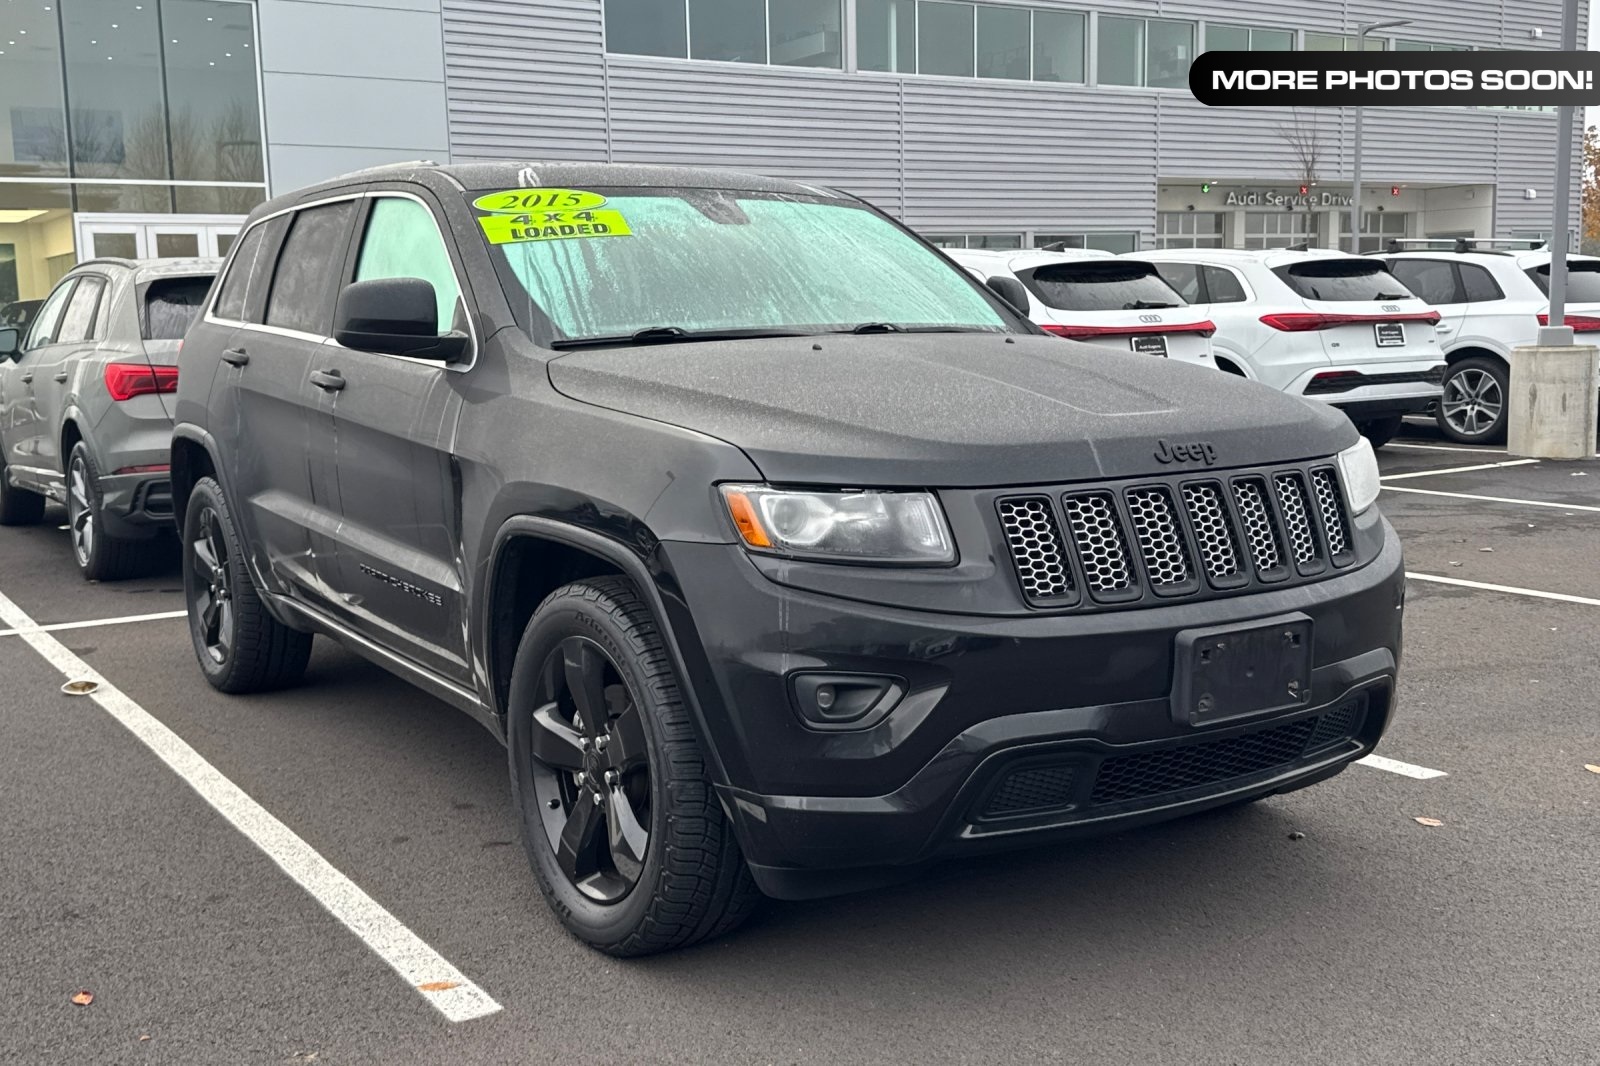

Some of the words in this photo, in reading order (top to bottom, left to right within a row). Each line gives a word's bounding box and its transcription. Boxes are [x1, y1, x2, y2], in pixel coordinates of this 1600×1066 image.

[501, 193, 583, 209] 2015
[1226, 191, 1261, 206] Audi
[1265, 191, 1318, 206] Service
[511, 223, 610, 239] LOADED
[1154, 439, 1217, 466] Jeep
